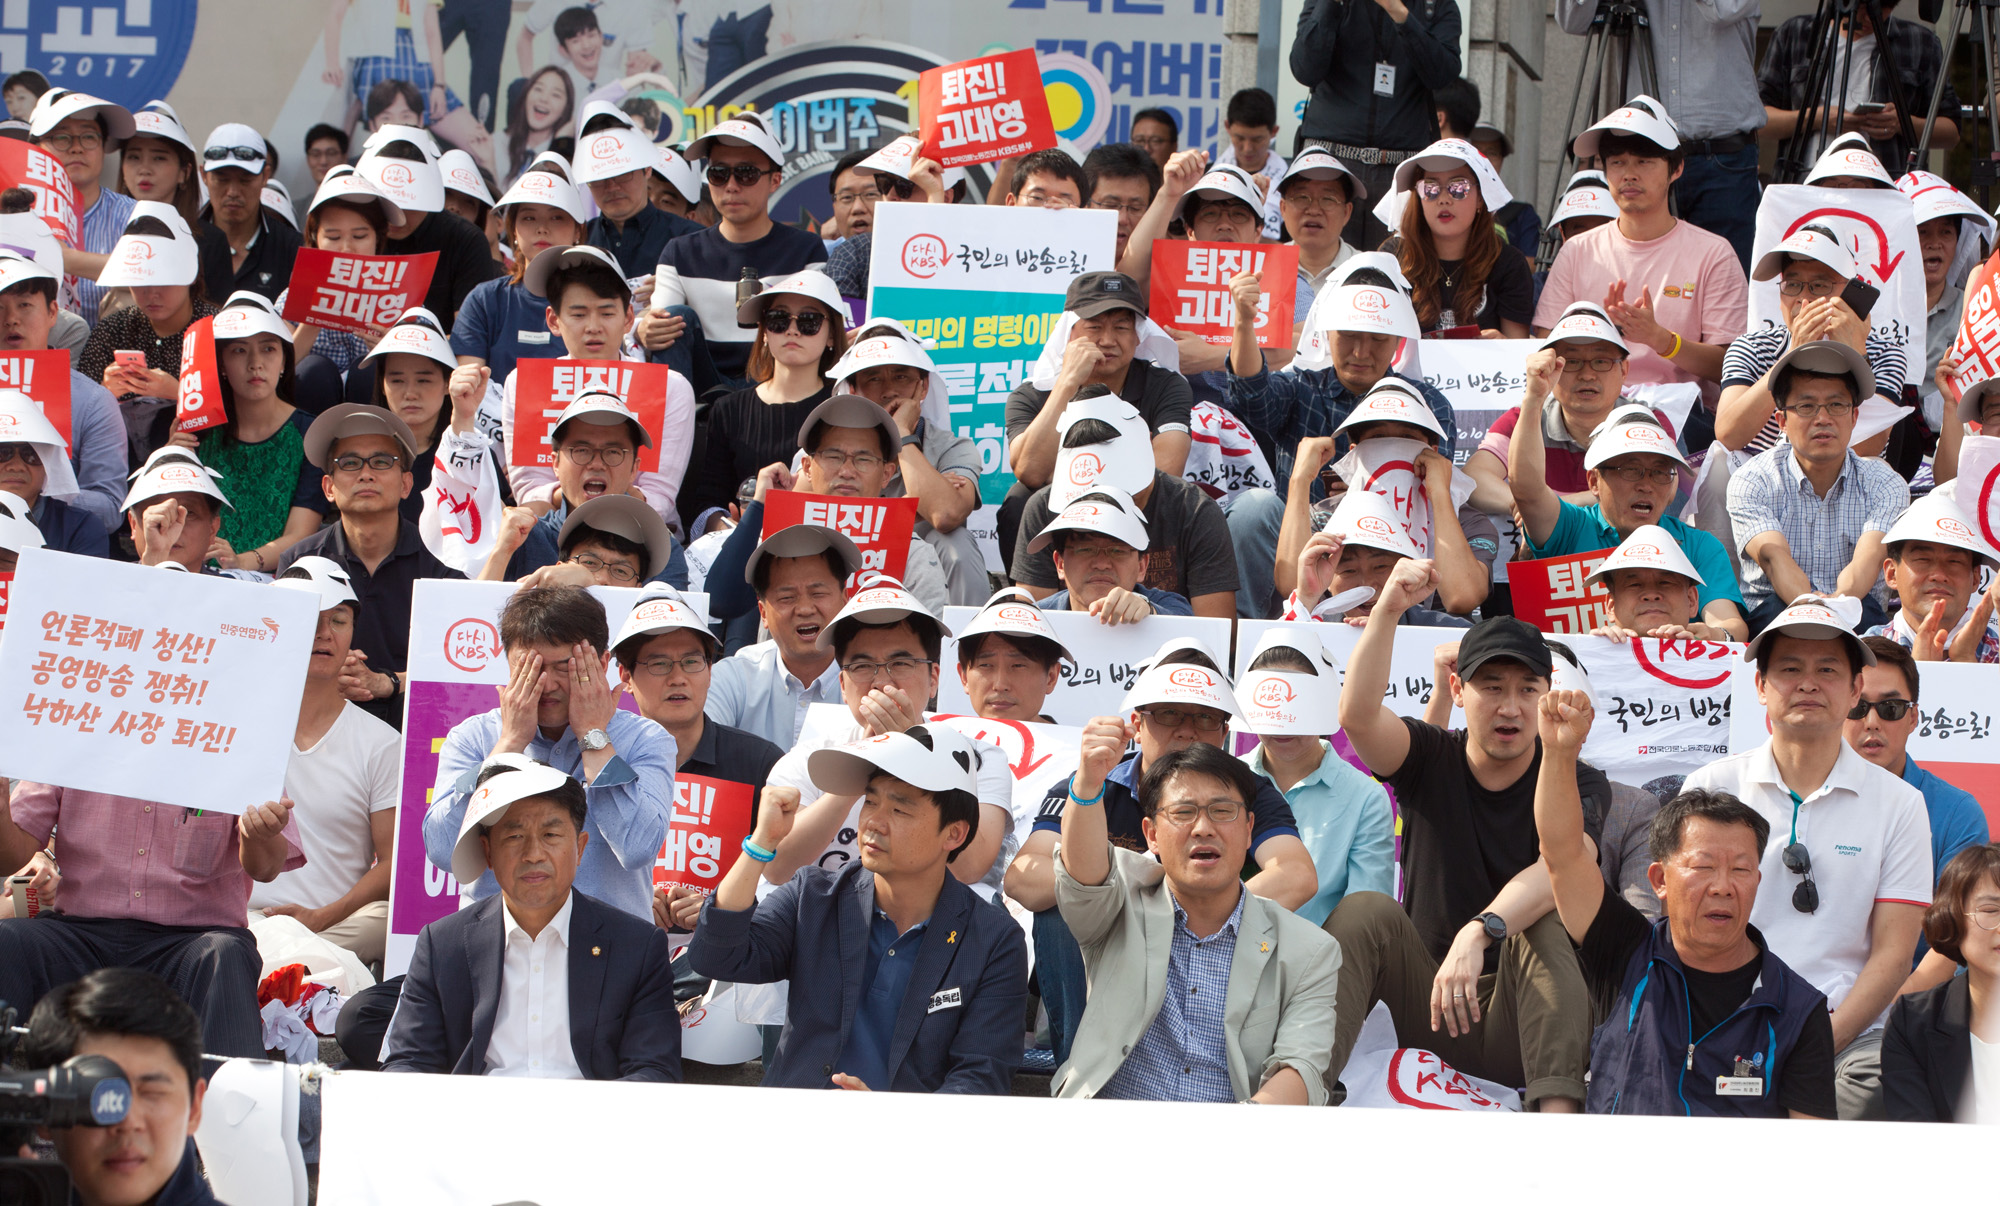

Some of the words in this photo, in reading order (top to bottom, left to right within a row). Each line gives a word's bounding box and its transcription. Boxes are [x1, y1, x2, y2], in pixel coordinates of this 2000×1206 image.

[49, 56, 146, 78] 2017
[941, 61, 1007, 107] 퇴진!
[772, 98, 880, 153] 이번주
[936, 99, 1028, 149] 고대영
[910, 254, 938, 269] KBS,
[912, 243, 936, 253] 다시
[956, 244, 1009, 273] 국민의
[1016, 247, 1087, 275] 방송으로!
[327, 256, 409, 291] 퇴진!
[310, 286, 408, 324] 고대영
[41, 611, 145, 652] 언론적폐
[152, 628, 217, 665] 청산!
[219, 623, 268, 641] 민중연합당
[455, 645, 489, 662] KBS,
[457, 629, 486, 642] 다시
[31, 651, 135, 698] 공영방송
[144, 670, 209, 706] 쟁취!
[22, 693, 103, 733] 낙하산
[108, 710, 165, 745] 사장
[171, 718, 237, 754] 퇴진!
[1608, 696, 1681, 733] 국민의
[1834, 844, 1862, 853] renoma
